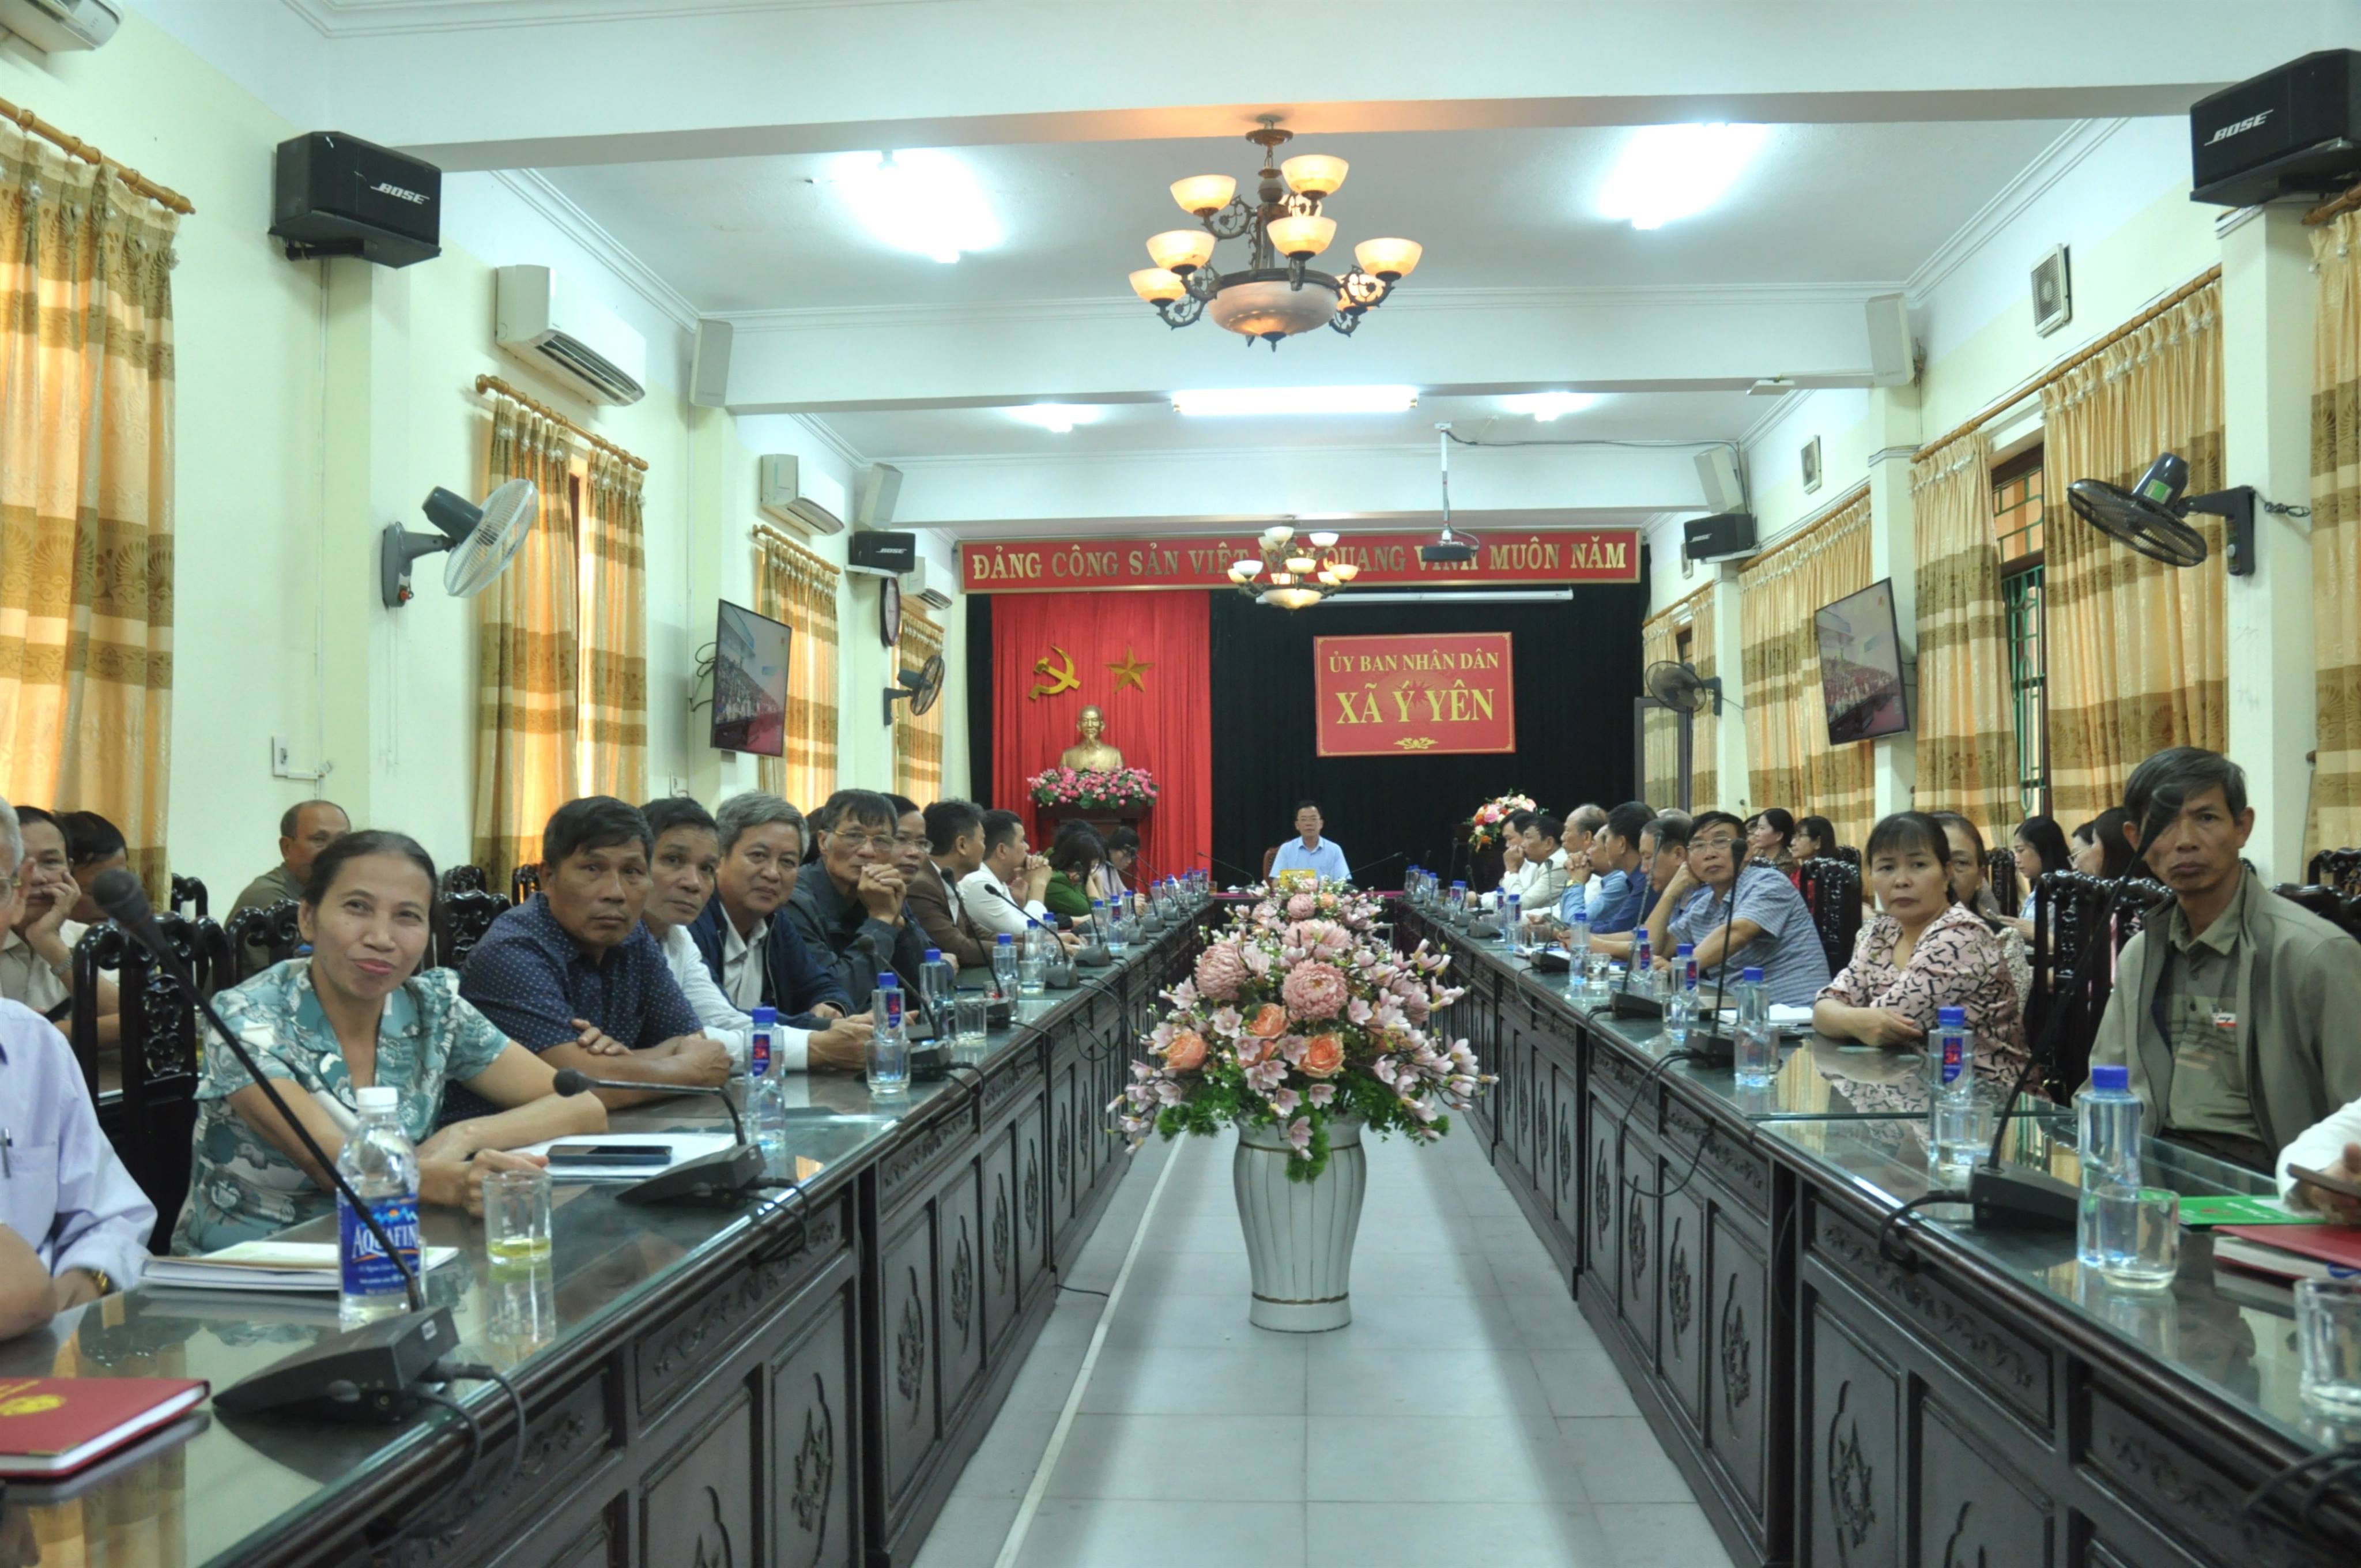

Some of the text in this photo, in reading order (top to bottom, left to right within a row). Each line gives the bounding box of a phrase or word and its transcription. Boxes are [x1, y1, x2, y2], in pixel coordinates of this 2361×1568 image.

[2204, 109, 2274, 146] BOSE
[370, 182, 430, 205] BOSE
[972, 545, 1042, 579] ĐẢNG
[1051, 544, 1119, 581] CỘNG
[1128, 542, 1179, 576] SẢN
[1489, 536, 1560, 570] MUÔN
[1570, 536, 1626, 569] NĂM
[1329, 647, 1499, 673] ỦY BAN NHÂN DÂN
[1336, 679, 1494, 724] XÃ Ý YÊN
[352, 1224, 419, 1258] AQAFIN
